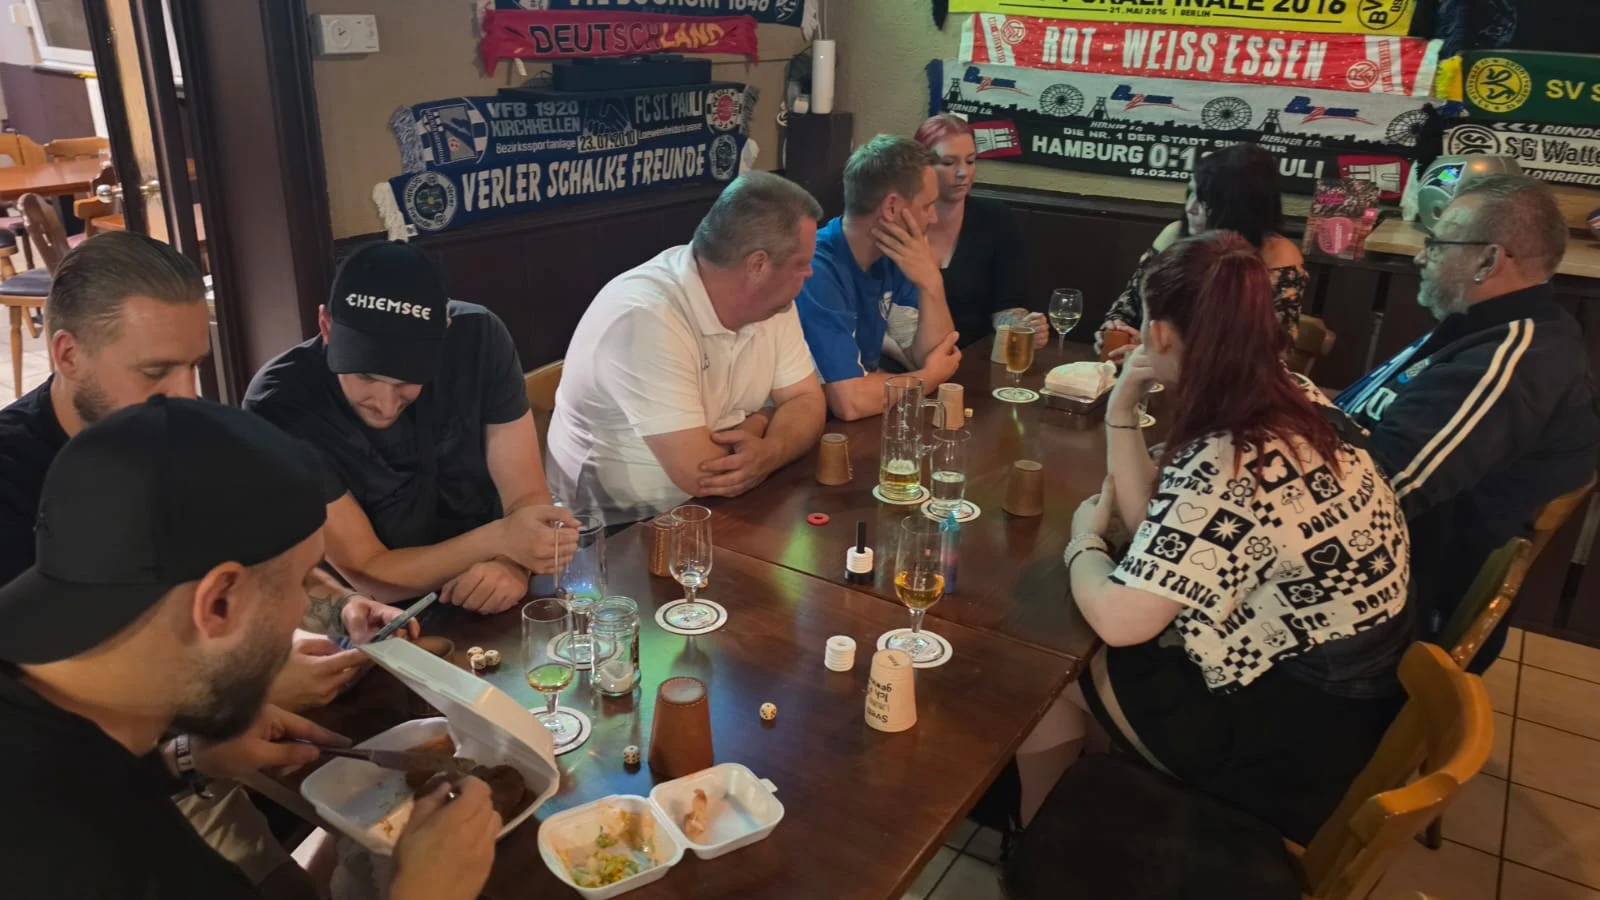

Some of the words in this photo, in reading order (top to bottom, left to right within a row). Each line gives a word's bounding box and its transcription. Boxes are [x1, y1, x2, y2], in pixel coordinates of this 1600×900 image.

[1180, 9, 1211, 17] BERLIN
[529, 22, 725, 54] DEUTSCHLAND
[1042, 26, 1096, 65] ROT
[1123, 28, 1218, 73] WEISS
[1223, 34, 1328, 81] ESSEN
[1546, 79, 1586, 100] SV
[486, 102, 528, 118] VFB
[534, 101, 579, 117] 1920
[635, 95, 653, 125] FC
[671, 89, 703, 120] PAULI
[490, 116, 580, 137] KIRCHHELLEN
[1064, 127, 1085, 137] DIE
[1089, 131, 1111, 140] NR.
[1116, 132, 1123, 140] 1
[1128, 132, 1156, 142] DER
[1161, 135, 1209, 146] STADT
[1032, 136, 1144, 164] HAMBURG
[1149, 143, 1195, 171] 0:1
[1279, 157, 1325, 179] ULI
[1505, 136, 1538, 161] SG
[462, 163, 541, 213] VERLER
[547, 153, 628, 198] SCHALKE
[632, 144, 706, 187] FREUNDE
[345, 293, 432, 320] CHIEMSEE
[1297, 501, 1349, 540] DON'T
[1348, 468, 1376, 513] PANIC
[1158, 570, 1221, 609] PANIC
